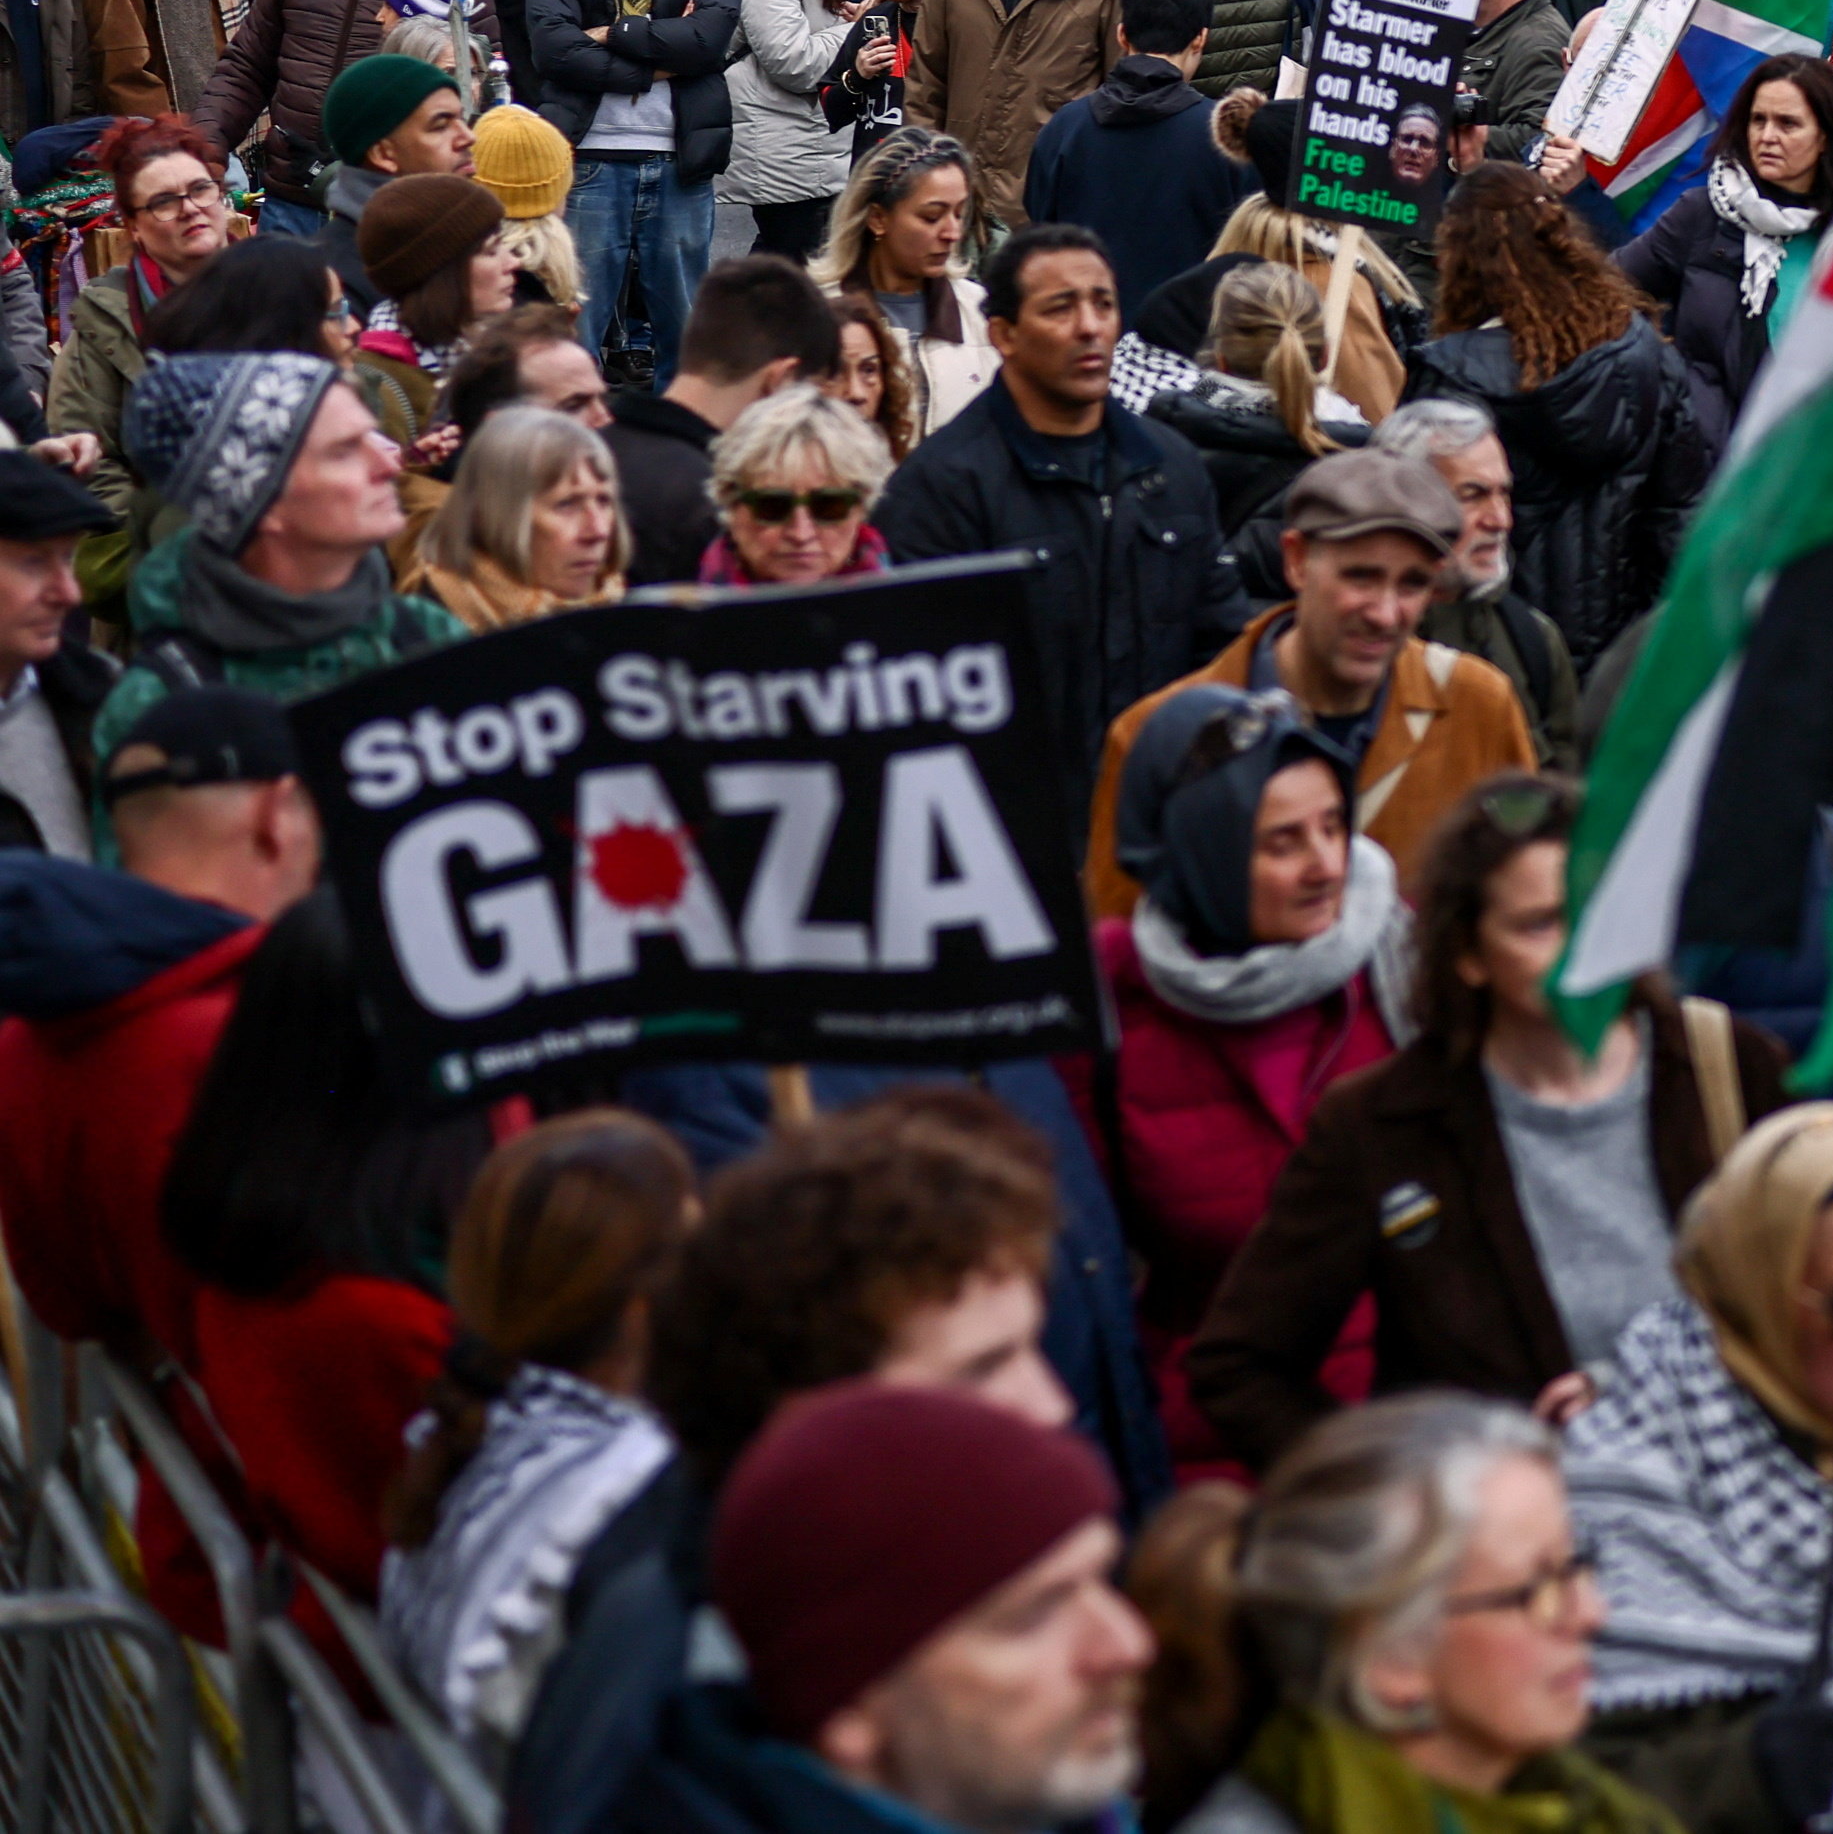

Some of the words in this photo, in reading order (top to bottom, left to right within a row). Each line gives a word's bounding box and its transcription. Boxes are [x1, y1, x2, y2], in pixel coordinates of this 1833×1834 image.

[1322, 30, 1372, 68] has
[1377, 42, 1452, 87] blood
[1316, 74, 1352, 102] on
[1356, 75, 1400, 112] his
[1309, 101, 1390, 146] hands
[1304, 136, 1366, 178] Free
[1298, 174, 1419, 225] Palestine
[341, 686, 584, 809] Stop
[600, 642, 1012, 741] Starving
[378, 742, 1058, 1021] GAZA
